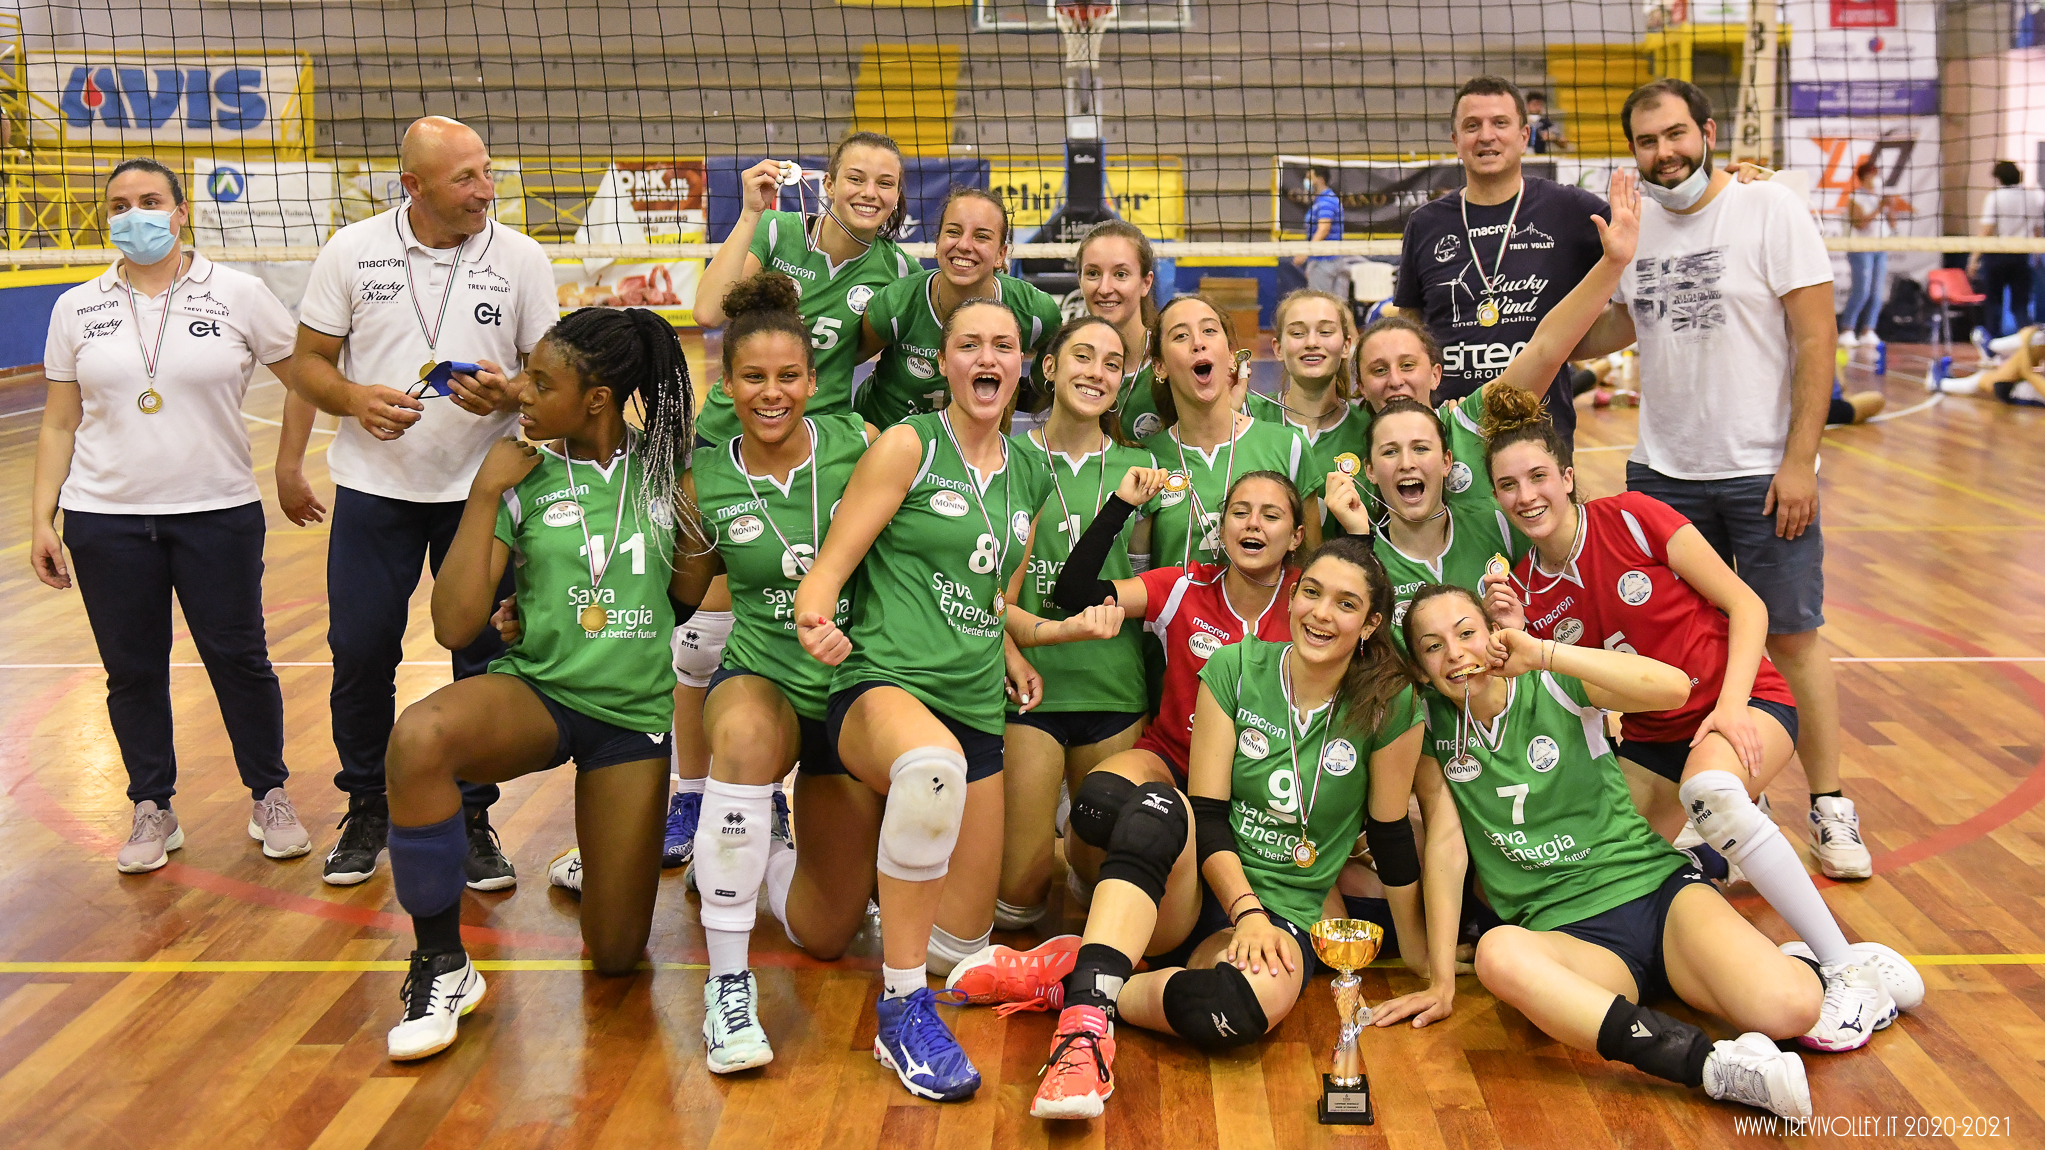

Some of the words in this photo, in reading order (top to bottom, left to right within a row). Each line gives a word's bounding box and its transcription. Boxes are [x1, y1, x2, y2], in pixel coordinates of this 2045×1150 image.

[61, 67, 267, 131] AVIS
[1468, 224, 1517, 239] macron
[1510, 243, 1529, 251] TREVI
[1531, 241, 1555, 249] VOLLEY
[358, 258, 405, 269] macron
[772, 256, 817, 280] macron
[360, 279, 405, 295] Lucky
[1480, 274, 1549, 296] Lucky
[76, 300, 119, 316] macron
[205, 308, 230, 317] VOLLEY
[83, 318, 123, 333] Lucky
[1501, 315, 1537, 325] pulita
[902, 343, 938, 358] macro
[909, 358, 932, 376] MONINI
[1464, 369, 1506, 380] GROU
[927, 472, 974, 494] macron
[535, 484, 590, 506] macron
[717, 498, 768, 520] macron
[934, 499, 966, 511] MONINI
[548, 510, 581, 521] MONINI
[731, 524, 760, 537] MONINI
[579, 532, 646, 576] 11
[781, 543, 817, 581] 6
[968, 533, 1001, 575] 8
[932, 572, 973, 601] Sava
[568, 586, 616, 606] Sava
[762, 588, 797, 605] Sav
[576, 604, 653, 630] Eergia
[1532, 596, 1575, 632] macron
[608, 629, 635, 639] better
[961, 622, 984, 637] better
[1192, 616, 1231, 640] macron
[1556, 622, 1582, 644] MONINI
[681, 639, 699, 650] errea
[1236, 707, 1287, 740] macron
[1241, 735, 1266, 755] MONINI
[1448, 764, 1479, 775] MONINI
[1267, 769, 1302, 823] 9
[1495, 783, 1530, 825] 7
[722, 826, 746, 835] errea
[1264, 850, 1292, 863] bette
